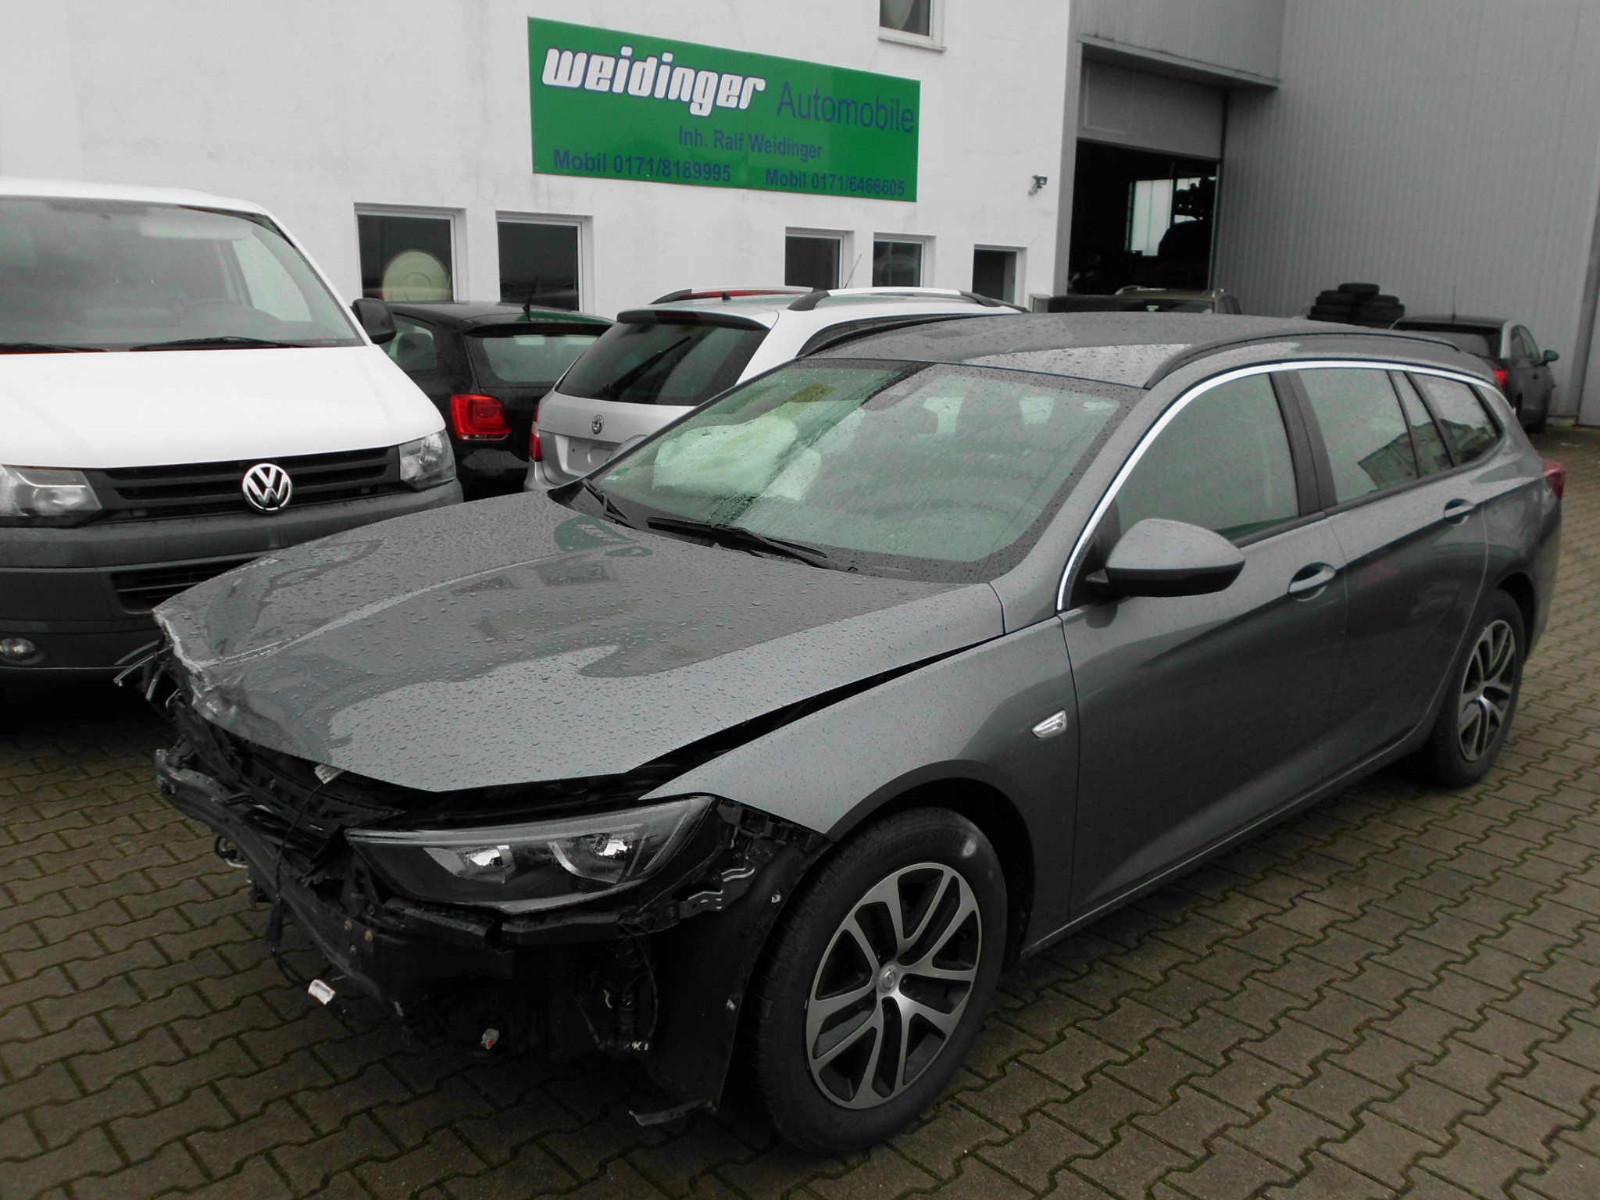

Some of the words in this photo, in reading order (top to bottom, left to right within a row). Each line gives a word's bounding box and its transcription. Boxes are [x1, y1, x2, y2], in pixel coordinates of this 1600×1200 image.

[541, 45, 767, 118] weidinger
[776, 80, 915, 134] Automobile
[679, 125, 709, 148] Inh.
[714, 128, 745, 152] Ralf
[749, 133, 823, 162] Weidinger
[553, 149, 607, 173] Mobil
[614, 153, 731, 183] 0171/8189995
[766, 168, 807, 188] Mobil
